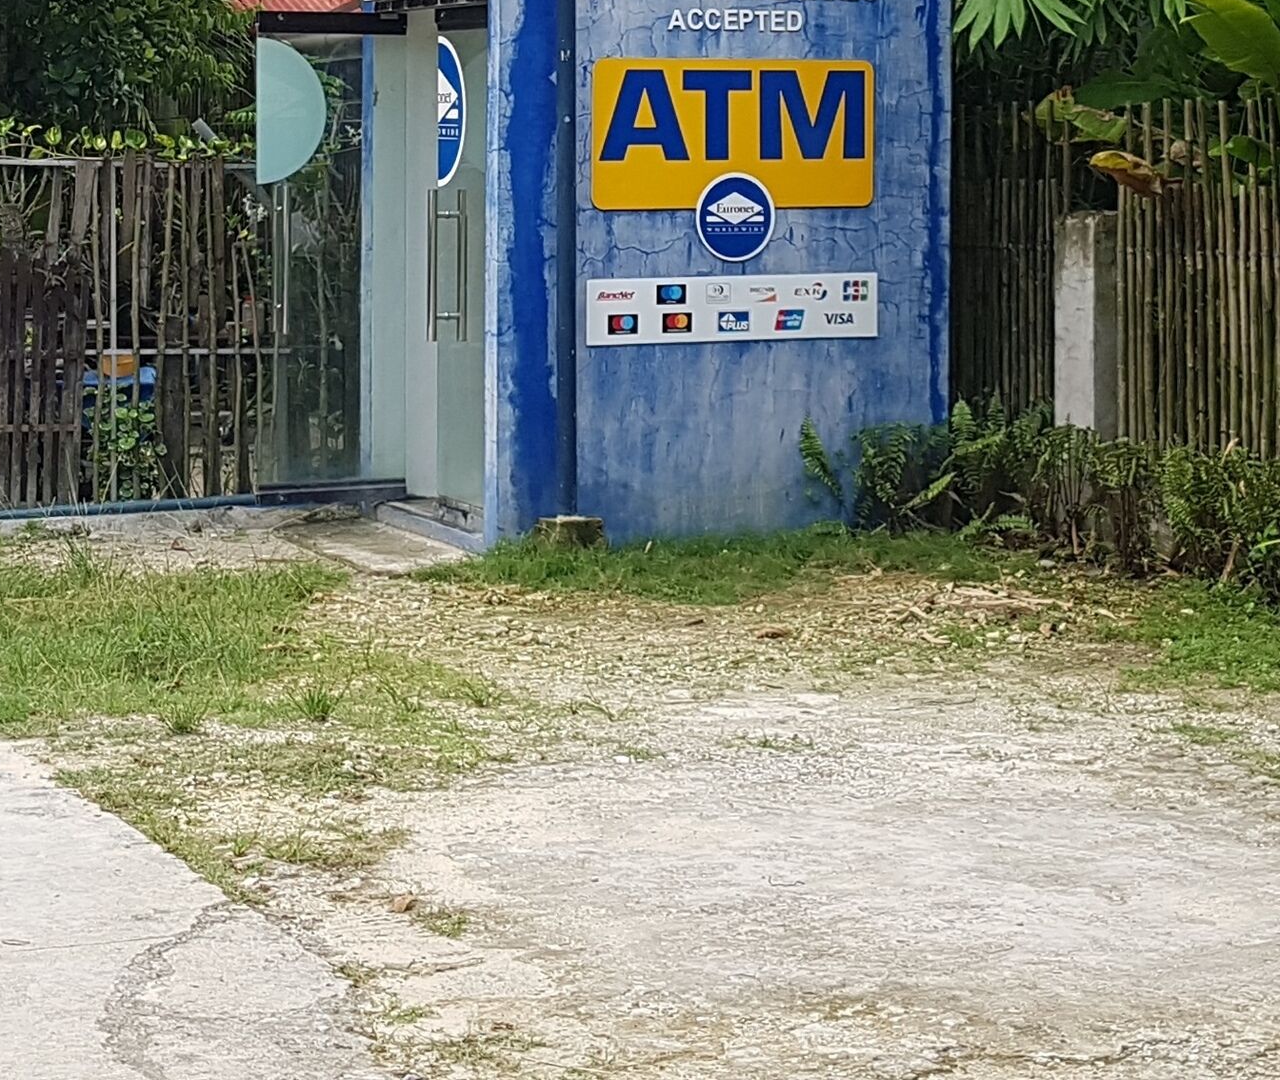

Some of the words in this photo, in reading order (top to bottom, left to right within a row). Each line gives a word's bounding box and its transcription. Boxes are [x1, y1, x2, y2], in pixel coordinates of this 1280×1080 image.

[667, 8, 804, 32] ACCEPTED
[599, 69, 866, 161] ATM
[716, 202, 755, 214] Euronet
[824, 312, 855, 325] VISA
[727, 320, 749, 331] PLUS
